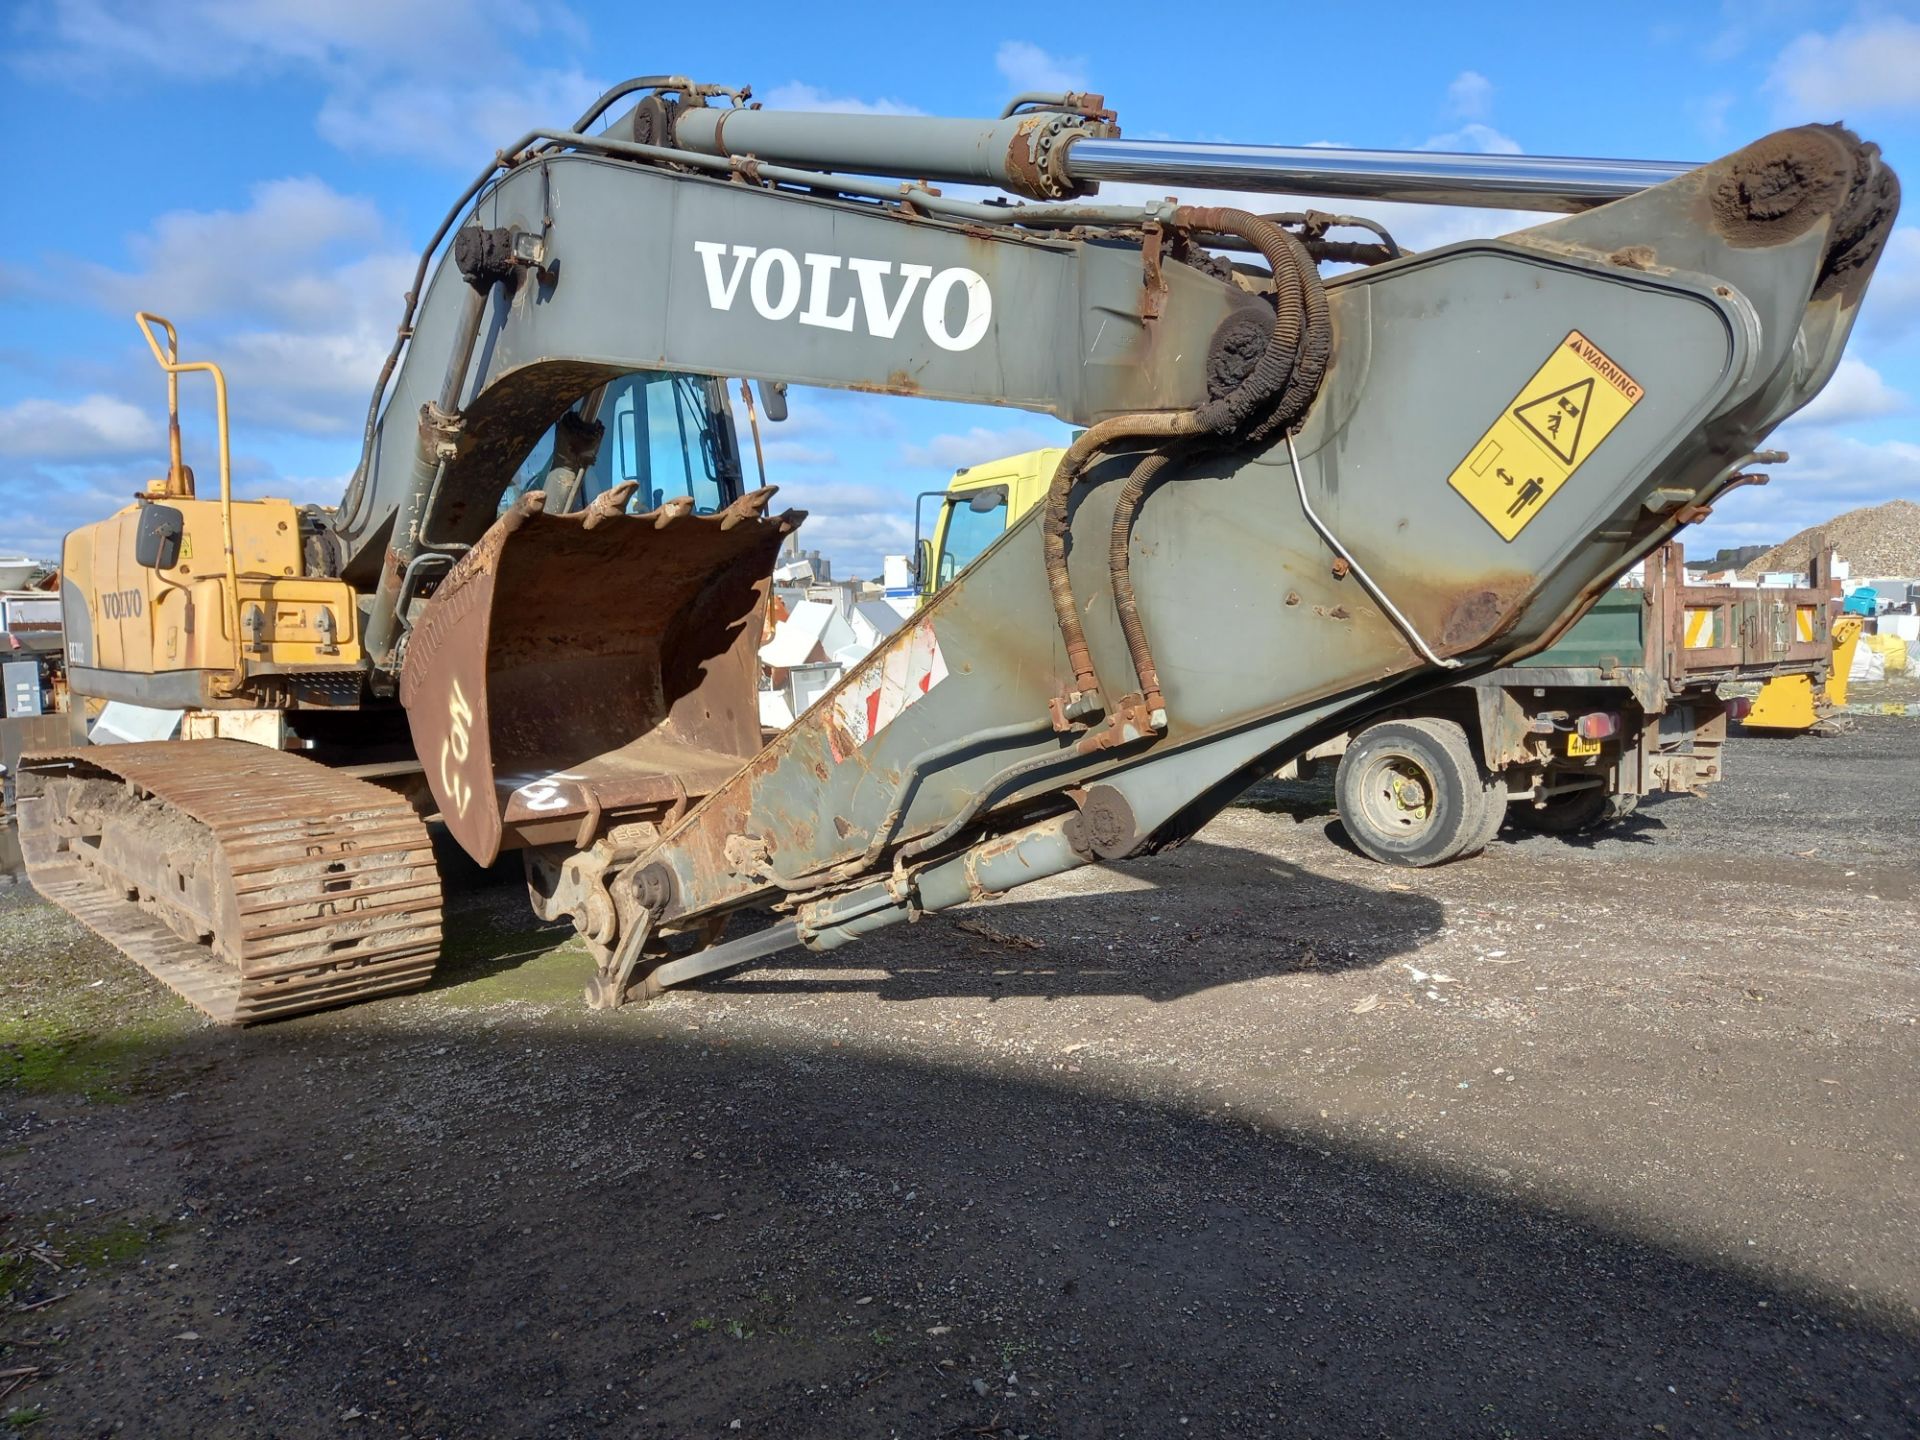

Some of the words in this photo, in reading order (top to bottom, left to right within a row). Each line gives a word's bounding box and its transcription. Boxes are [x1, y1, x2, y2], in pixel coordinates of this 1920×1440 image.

[694, 241, 992, 351] VOLVO
[1583, 346, 1638, 398] WARNING
[102, 589, 141, 619] VOLVO
